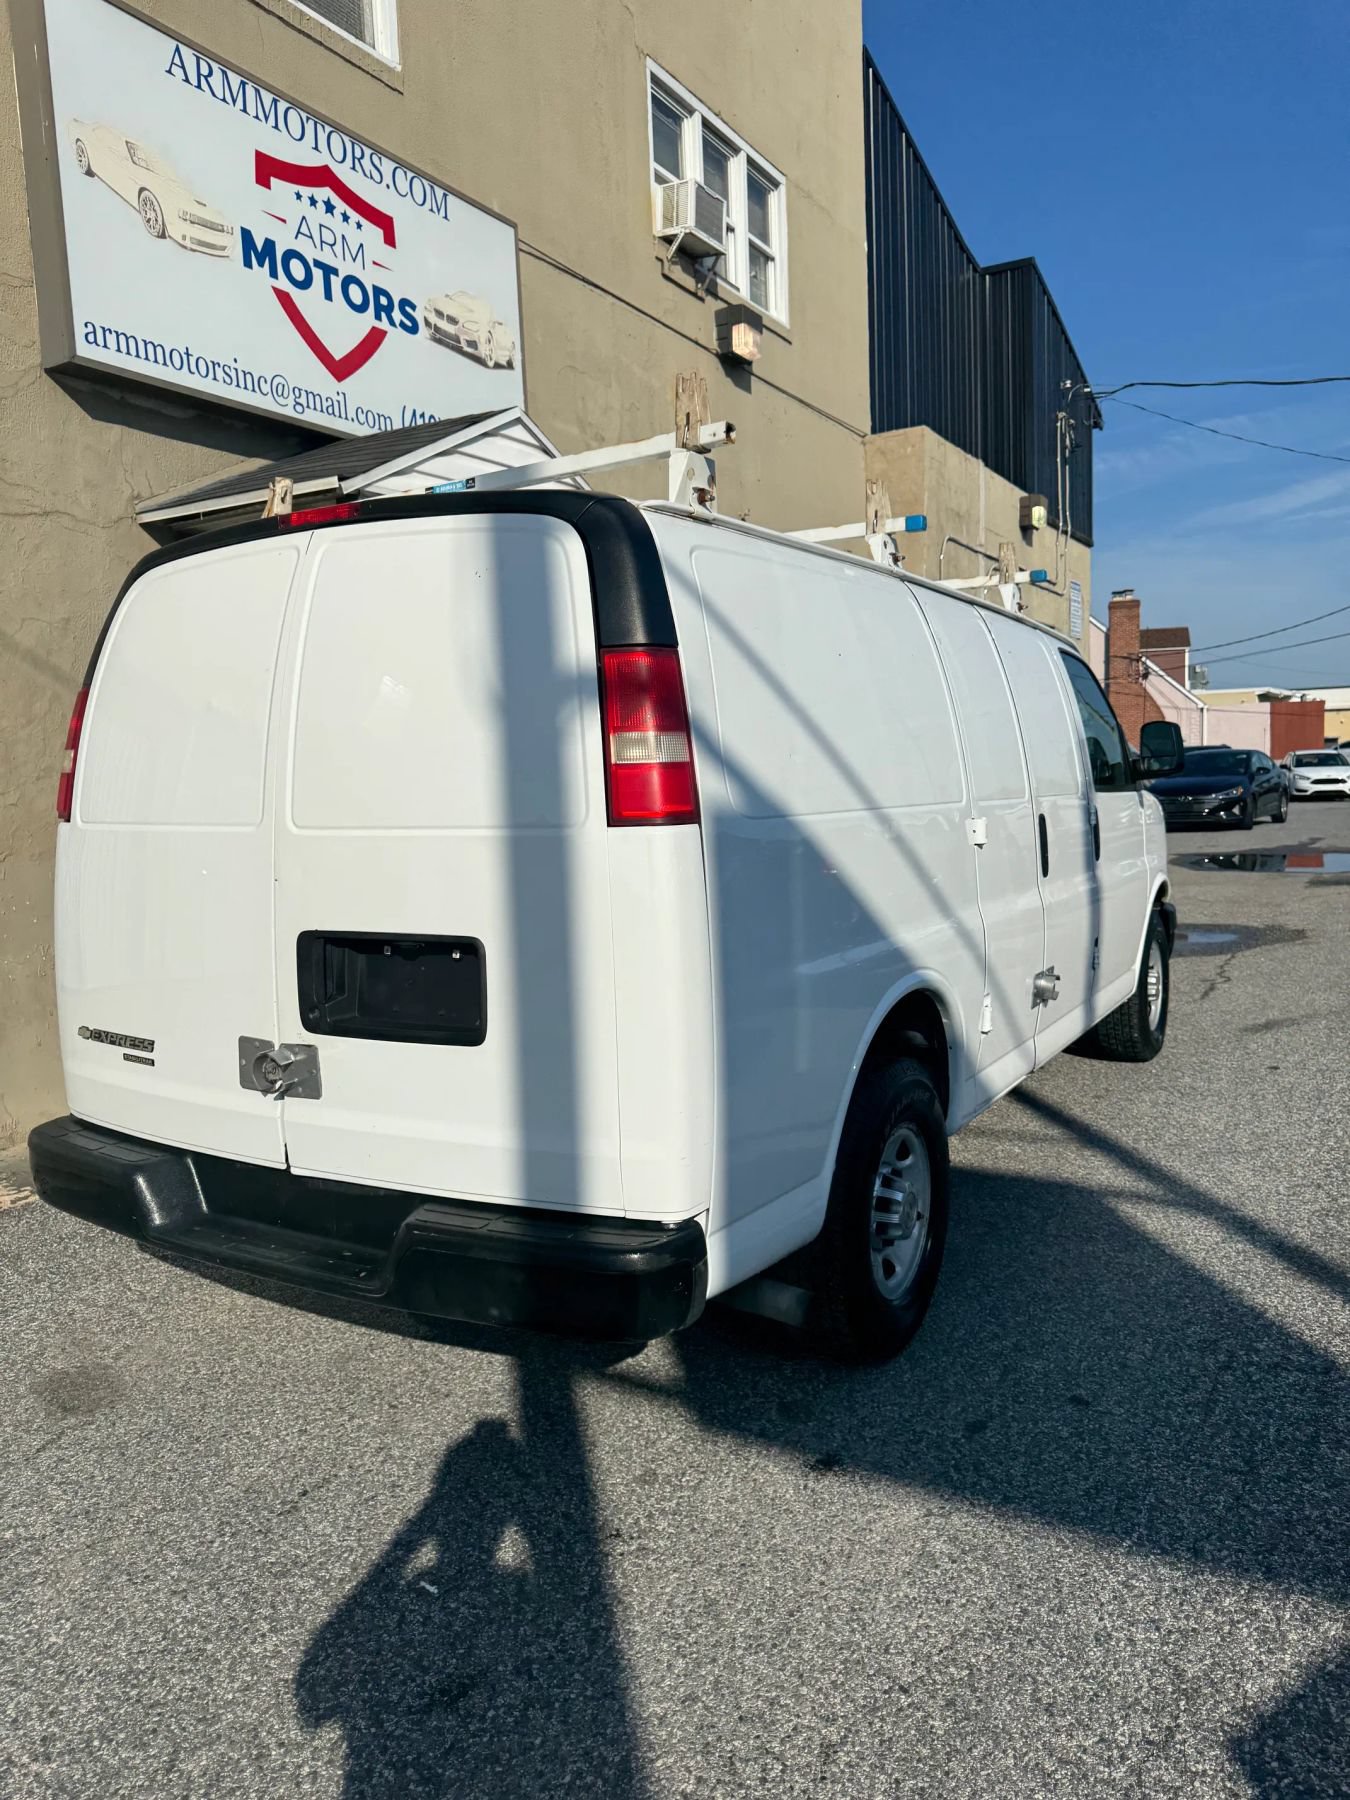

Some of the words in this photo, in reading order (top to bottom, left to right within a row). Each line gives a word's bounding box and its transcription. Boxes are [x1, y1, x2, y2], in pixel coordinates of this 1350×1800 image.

[165, 43, 451, 222] ARMMOTORS.COM
[240, 226, 420, 336] MOTORS
[295, 216, 366, 271] ARM
[84, 320, 394, 432] armmotorsinc@gmail.com
[91, 1029, 154, 1052] EXPRESS
